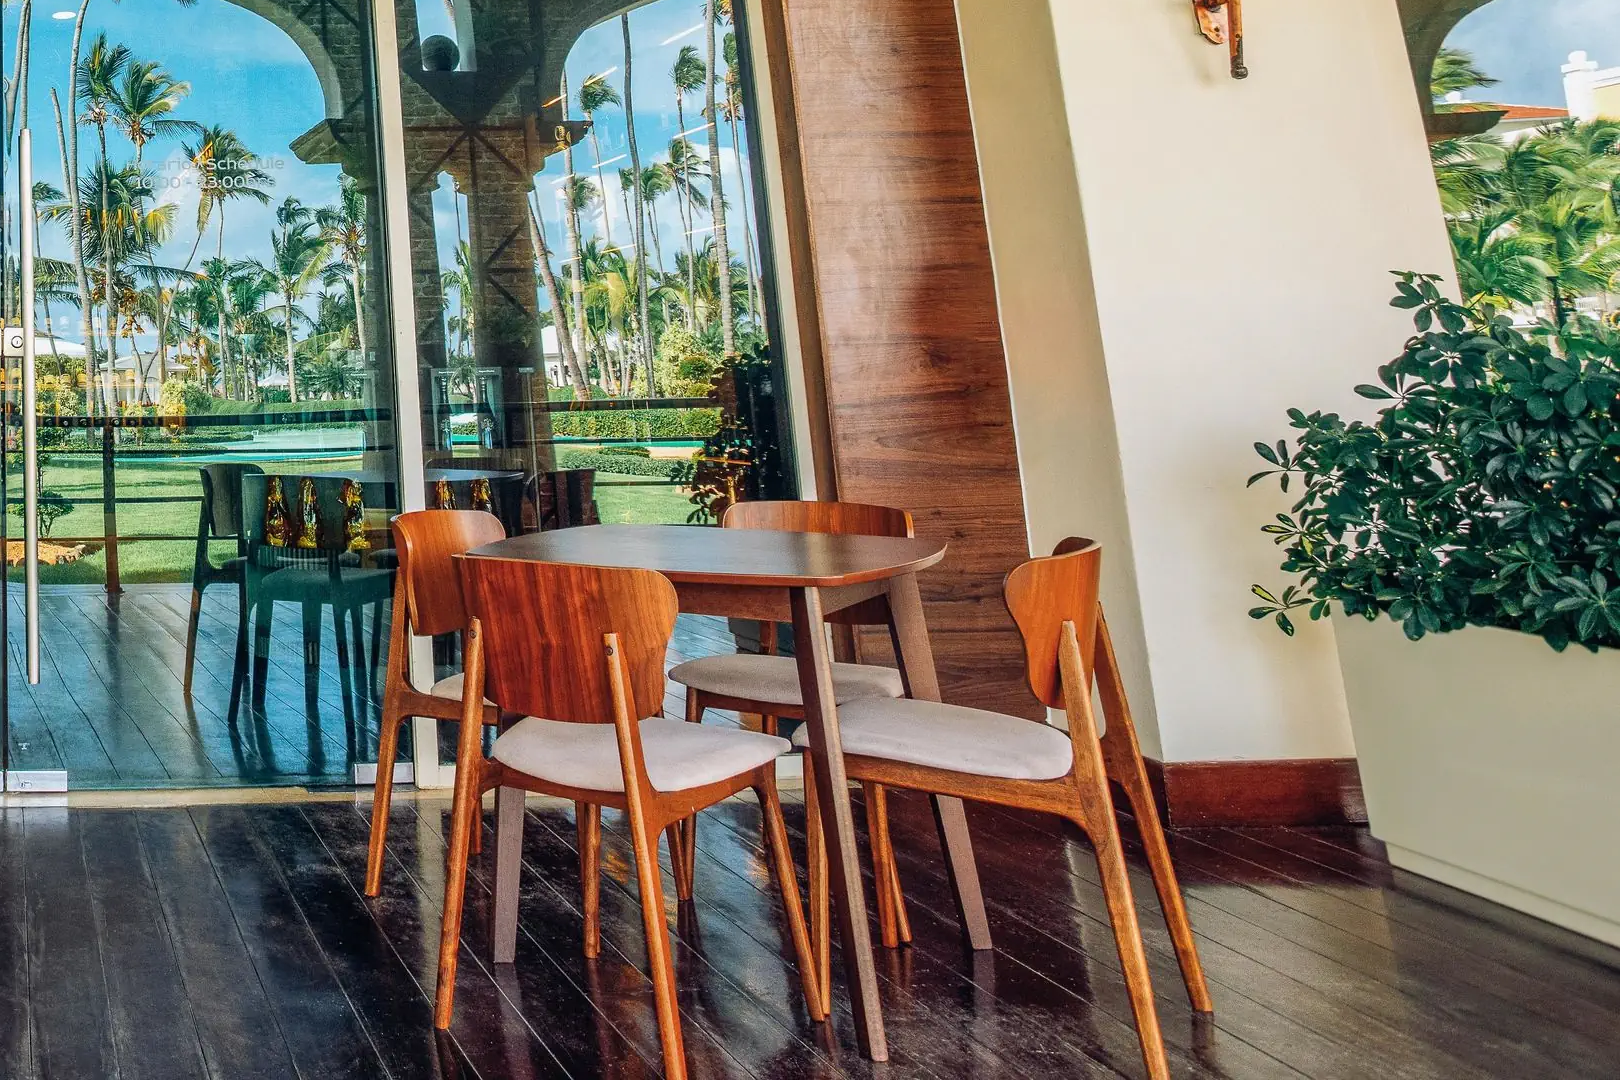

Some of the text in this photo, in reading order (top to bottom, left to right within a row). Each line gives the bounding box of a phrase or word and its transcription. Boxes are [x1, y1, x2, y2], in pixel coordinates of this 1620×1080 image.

[126, 158, 190, 170] Hario
[206, 157, 285, 171] Schedule
[136, 176, 181, 189] 1000
